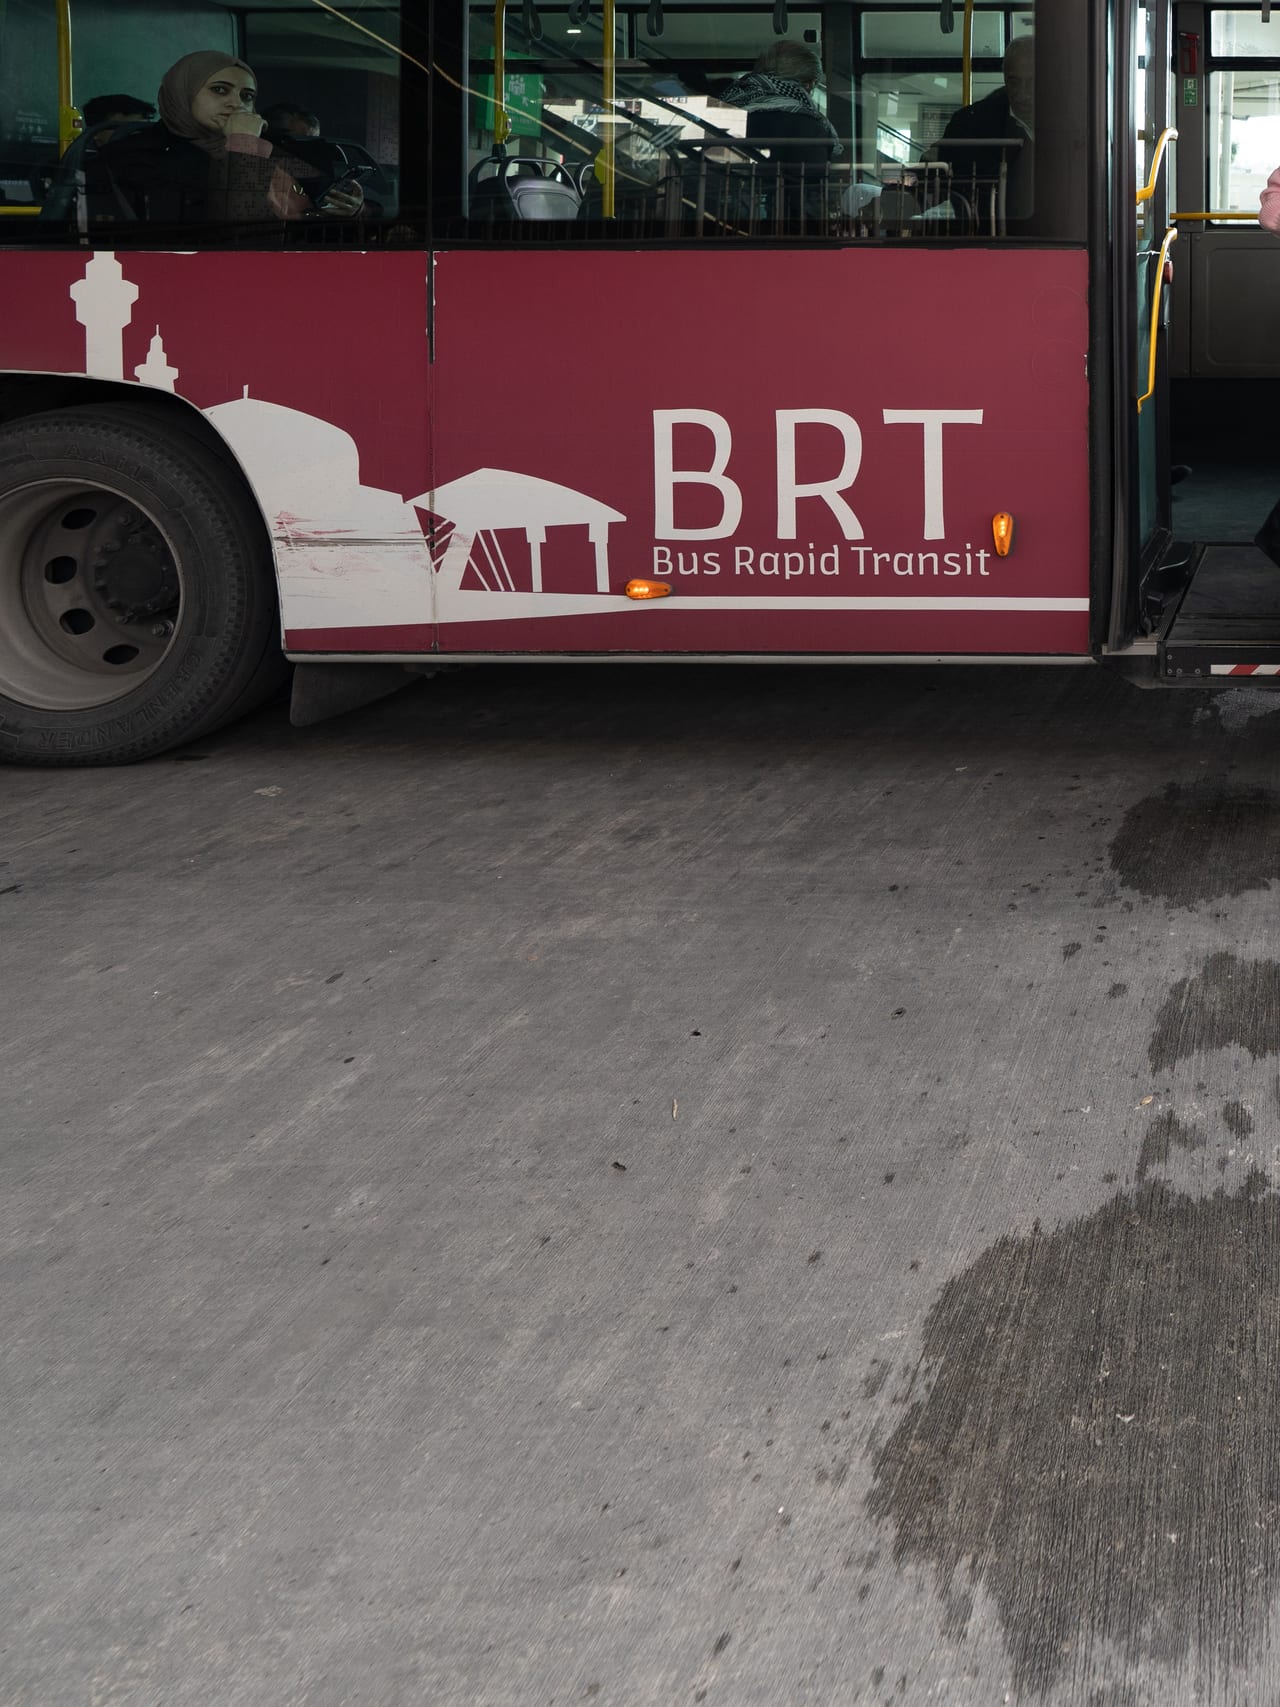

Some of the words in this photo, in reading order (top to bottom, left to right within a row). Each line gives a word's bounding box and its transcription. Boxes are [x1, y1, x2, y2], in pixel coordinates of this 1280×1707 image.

[652, 408, 984, 541] BRT
[652, 546, 721, 576] Bus
[735, 543, 840, 580] Rapid
[851, 542, 991, 577] Transit
